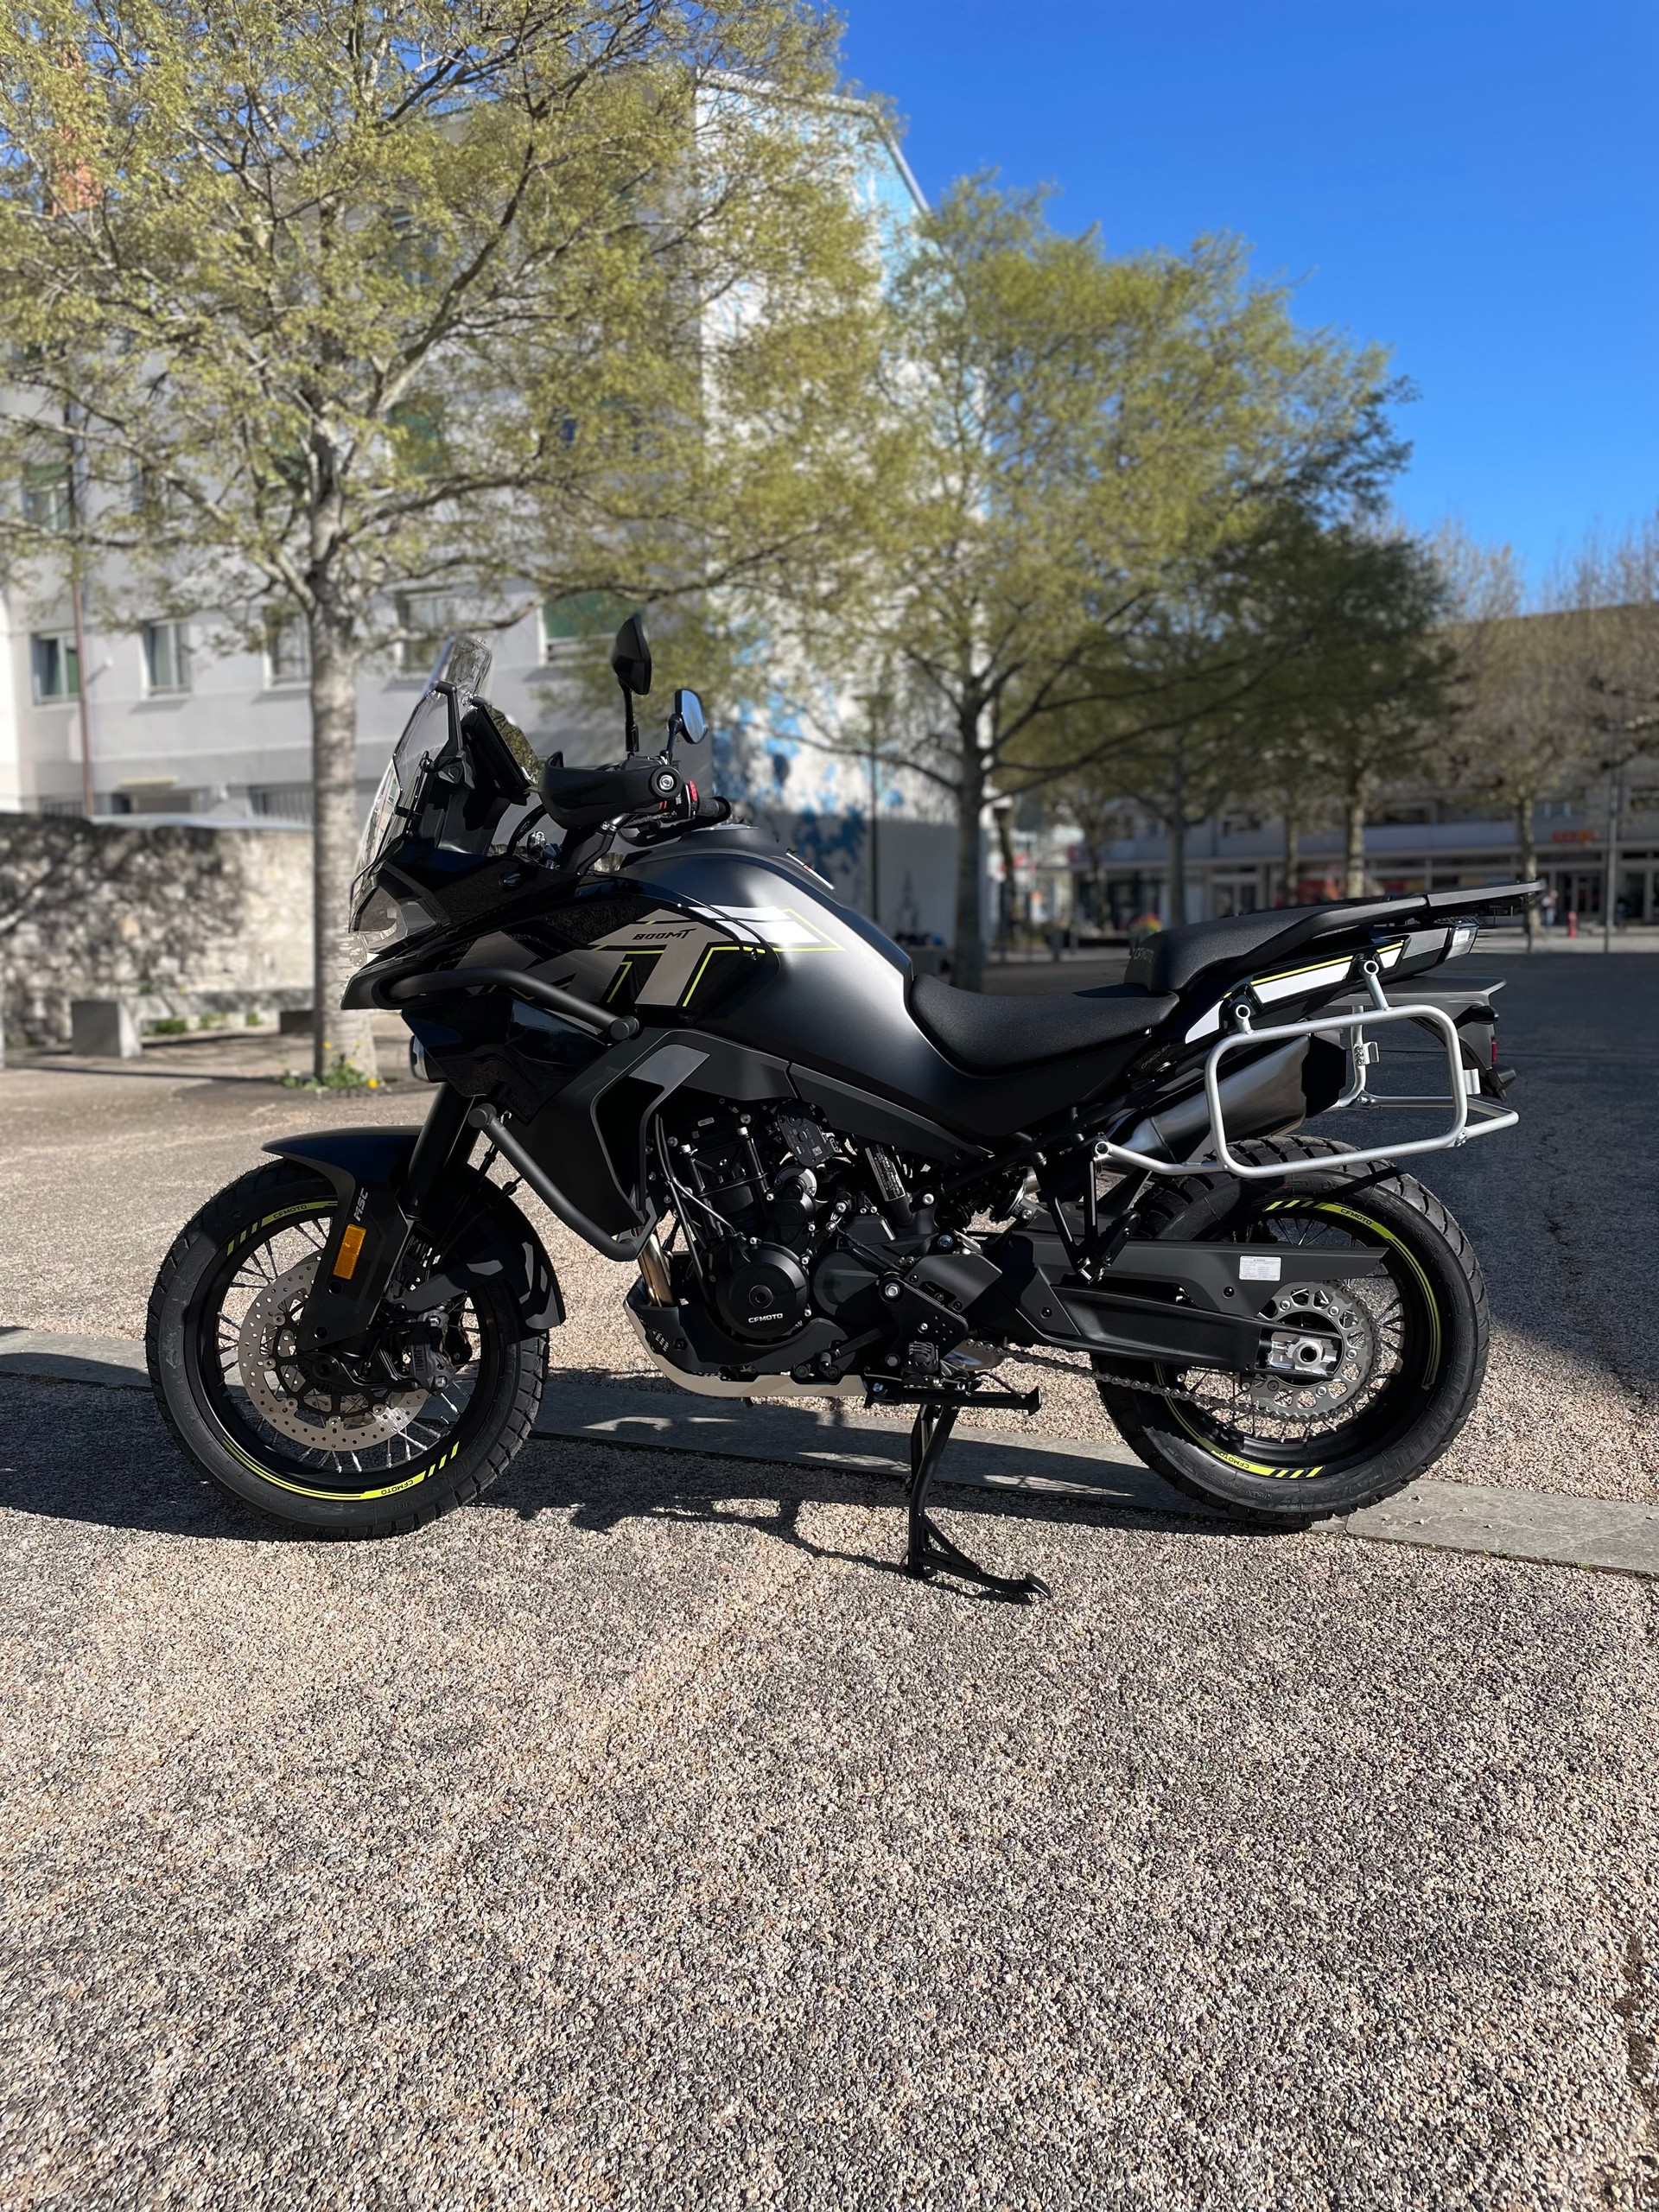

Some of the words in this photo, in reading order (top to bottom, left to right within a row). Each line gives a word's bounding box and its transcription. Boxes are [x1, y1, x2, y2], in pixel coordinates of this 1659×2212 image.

[632, 927, 698, 941] 800MT
[273, 1205, 308, 1219] CFMOTO
[353, 1186, 369, 1222] MSC
[1340, 1208, 1372, 1225] CFMOTO
[748, 1313, 784, 1324] CFMOTO
[1219, 1452, 1250, 1469] CFMOTO
[381, 1479, 413, 1495] CFMOTO
